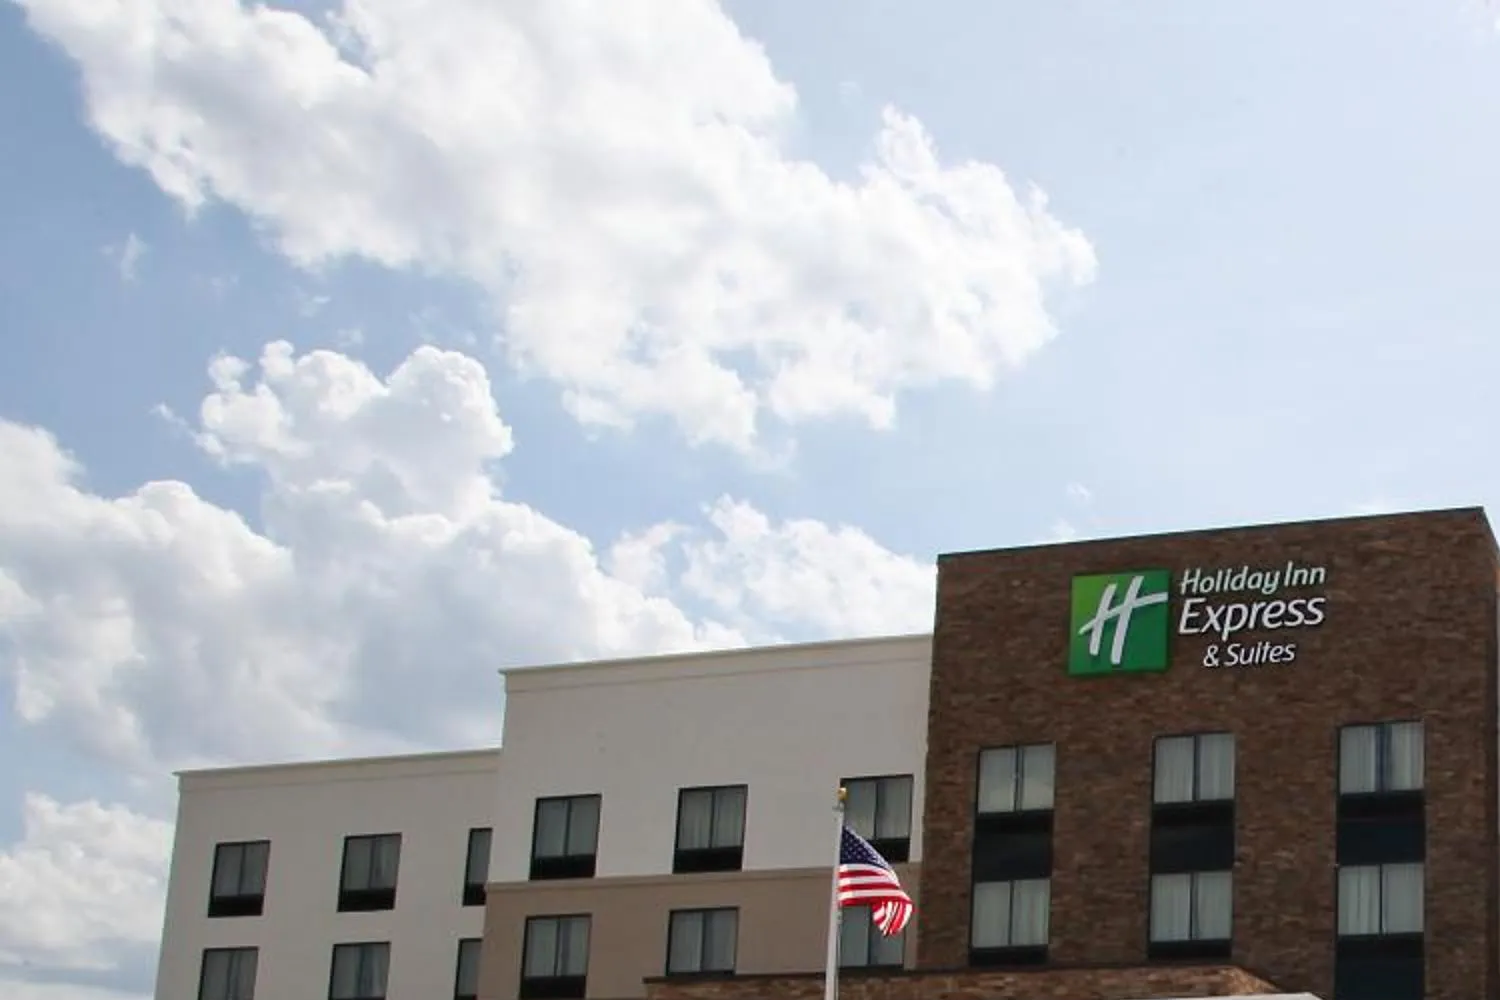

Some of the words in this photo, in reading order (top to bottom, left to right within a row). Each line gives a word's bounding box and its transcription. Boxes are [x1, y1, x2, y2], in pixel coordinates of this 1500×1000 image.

[1179, 565, 1281, 595] Holiday
[1283, 560, 1326, 586] Inn
[1178, 596, 1326, 641] Express
[1203, 644, 1219, 667] &
[1224, 640, 1296, 667] Suites
